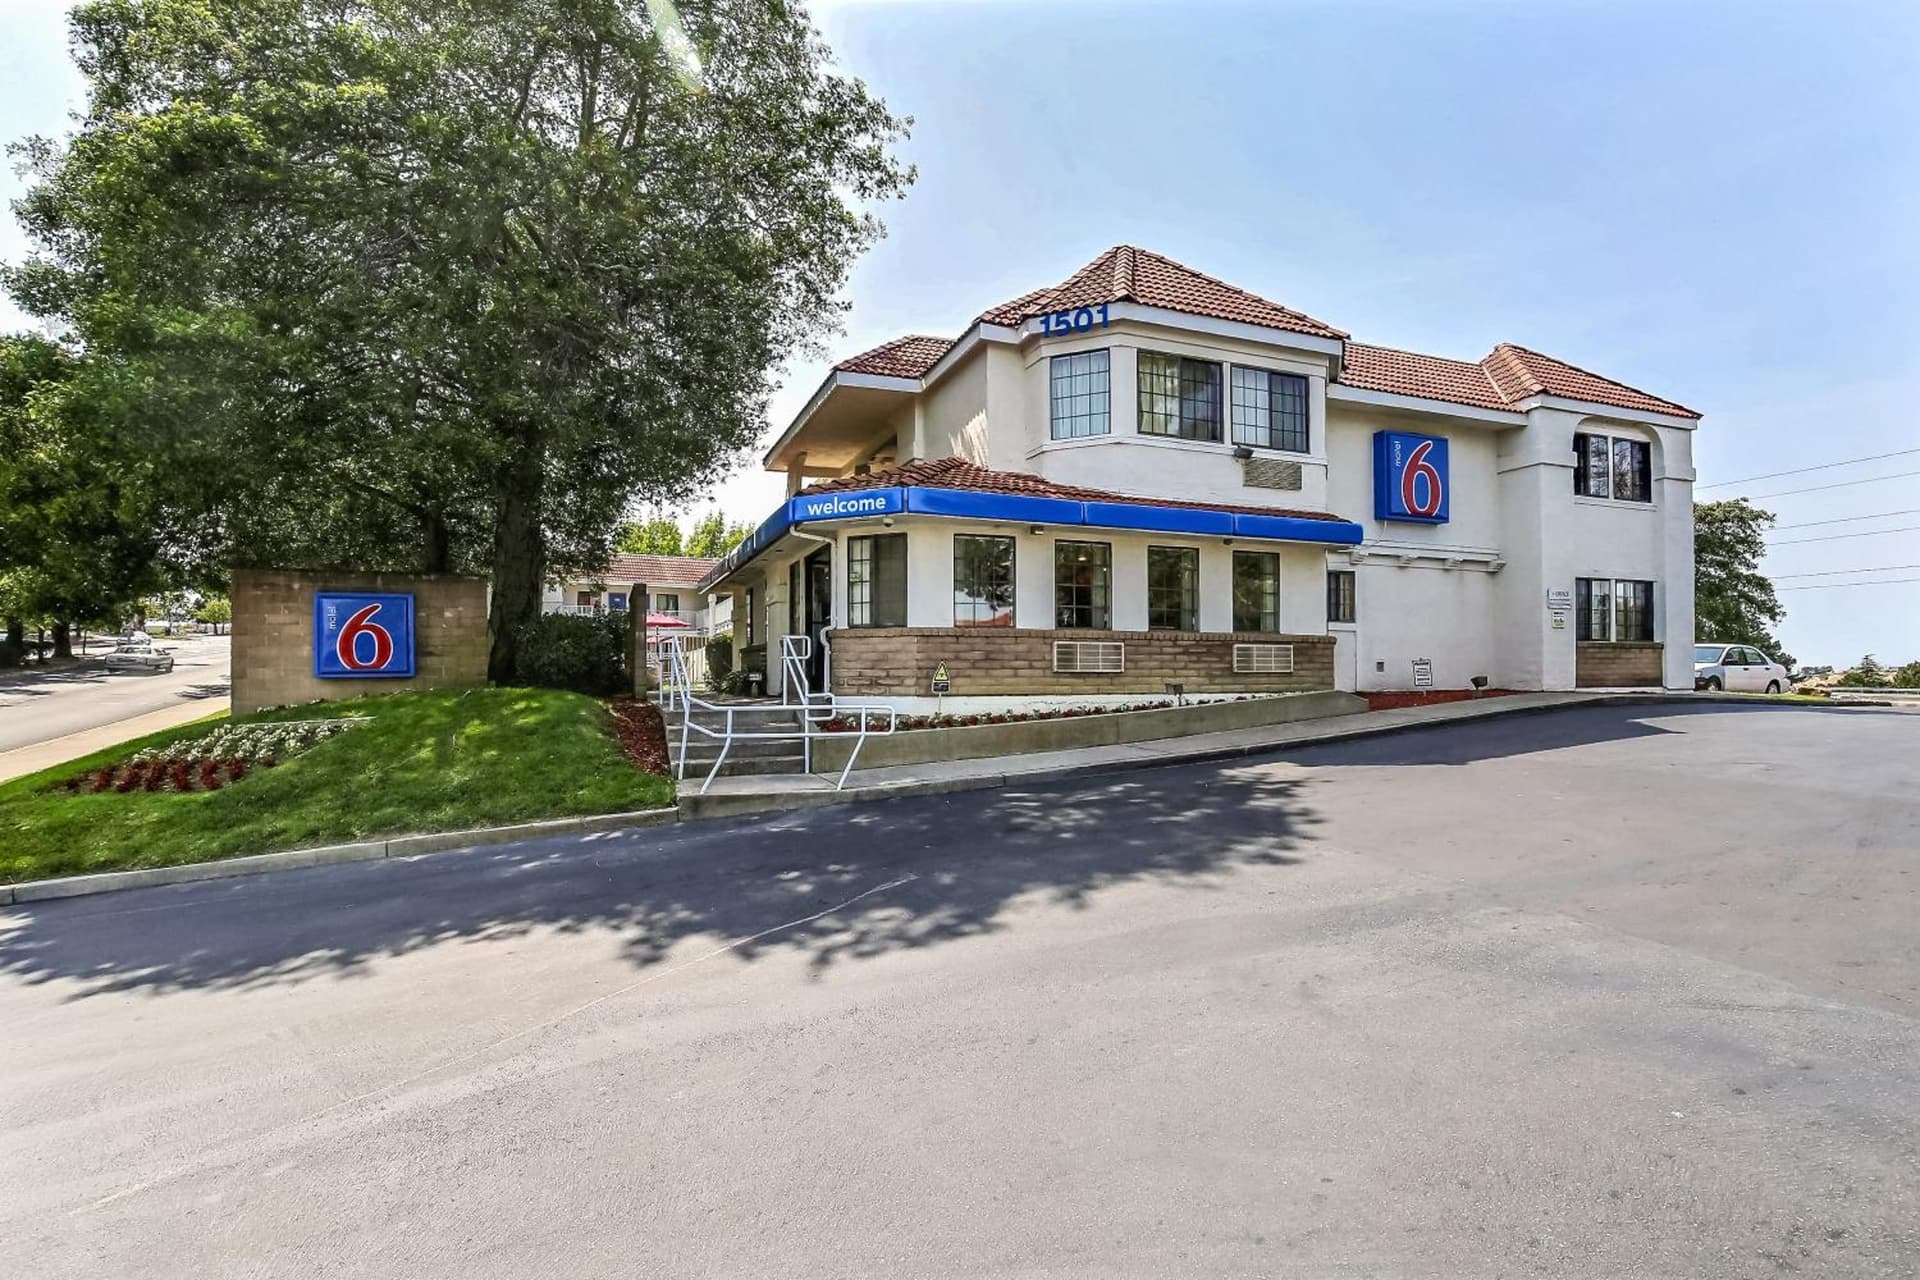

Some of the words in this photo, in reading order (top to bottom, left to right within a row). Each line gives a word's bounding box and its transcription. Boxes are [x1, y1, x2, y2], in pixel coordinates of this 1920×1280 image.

[1040, 303, 1109, 338] 1501
[1401, 440, 1442, 516] 6
[807, 496, 886, 515] welcome
[336, 603, 394, 670] 6
